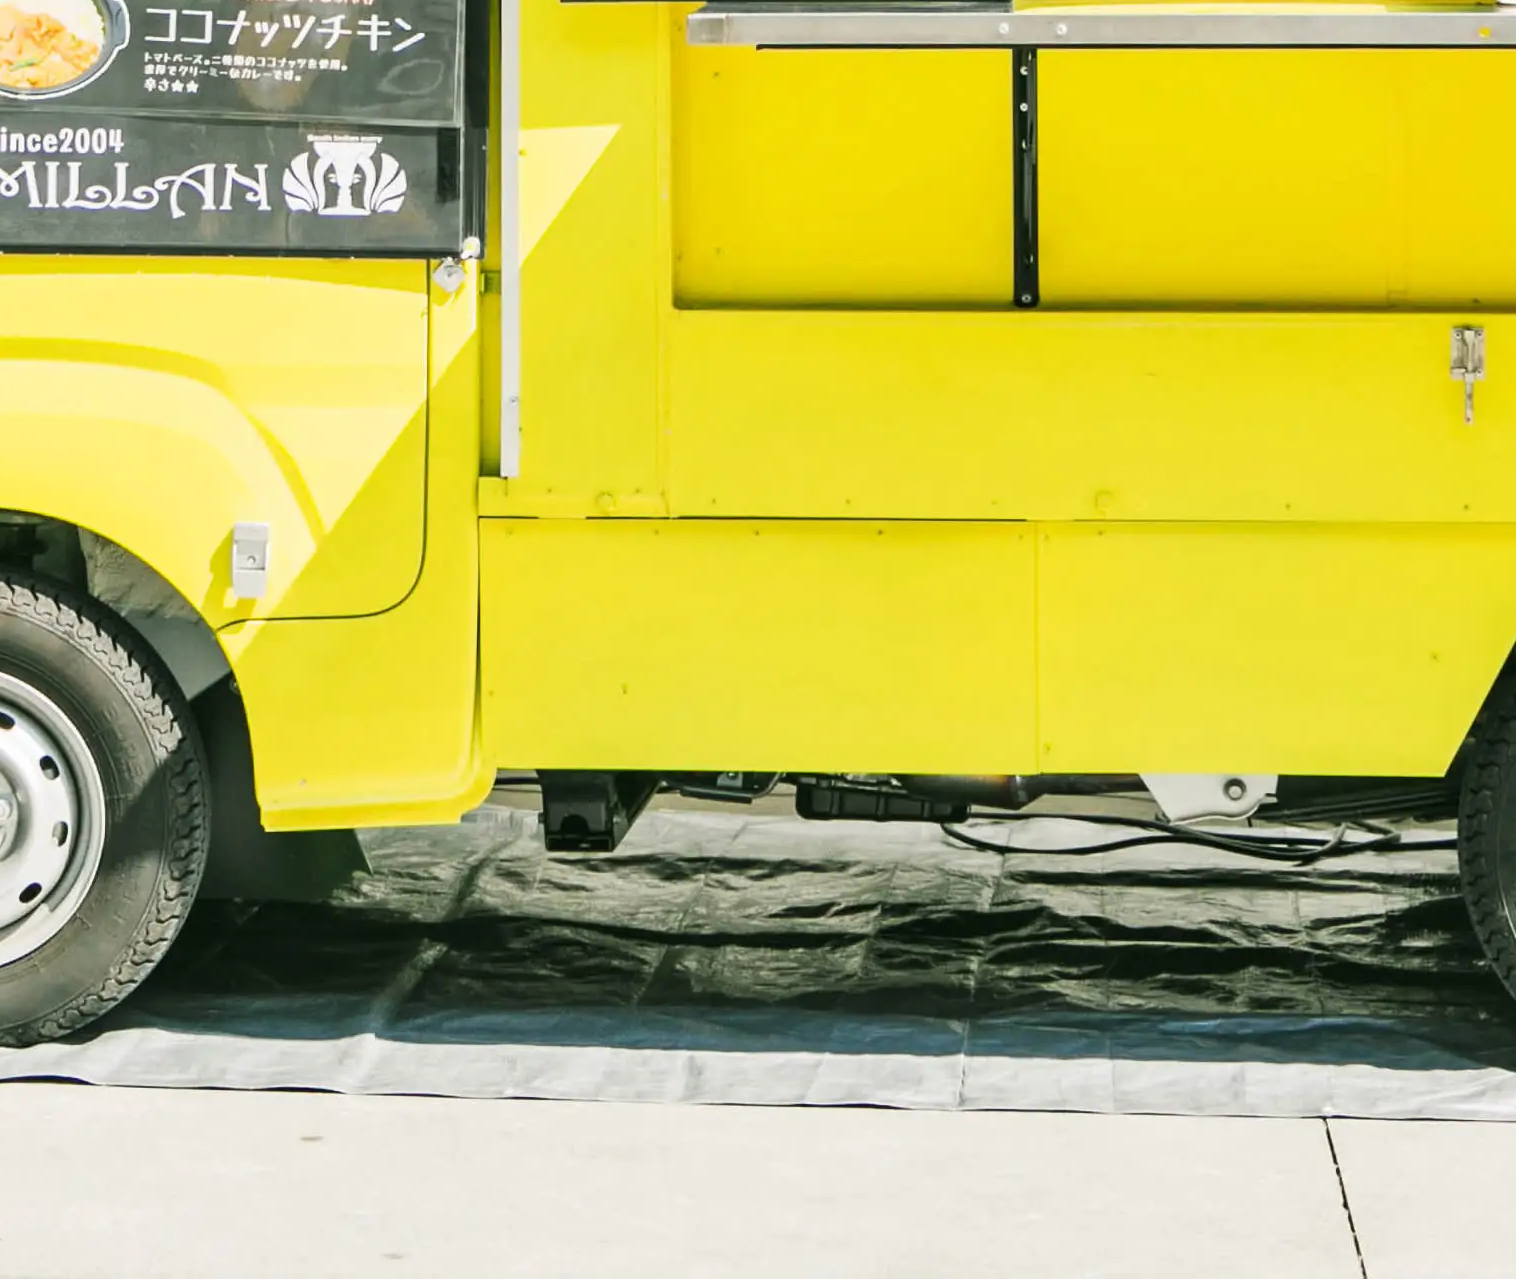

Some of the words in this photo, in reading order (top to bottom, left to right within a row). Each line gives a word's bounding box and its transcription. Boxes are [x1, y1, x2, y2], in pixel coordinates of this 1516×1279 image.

[144, 7, 426, 52] ココナッツチキン
